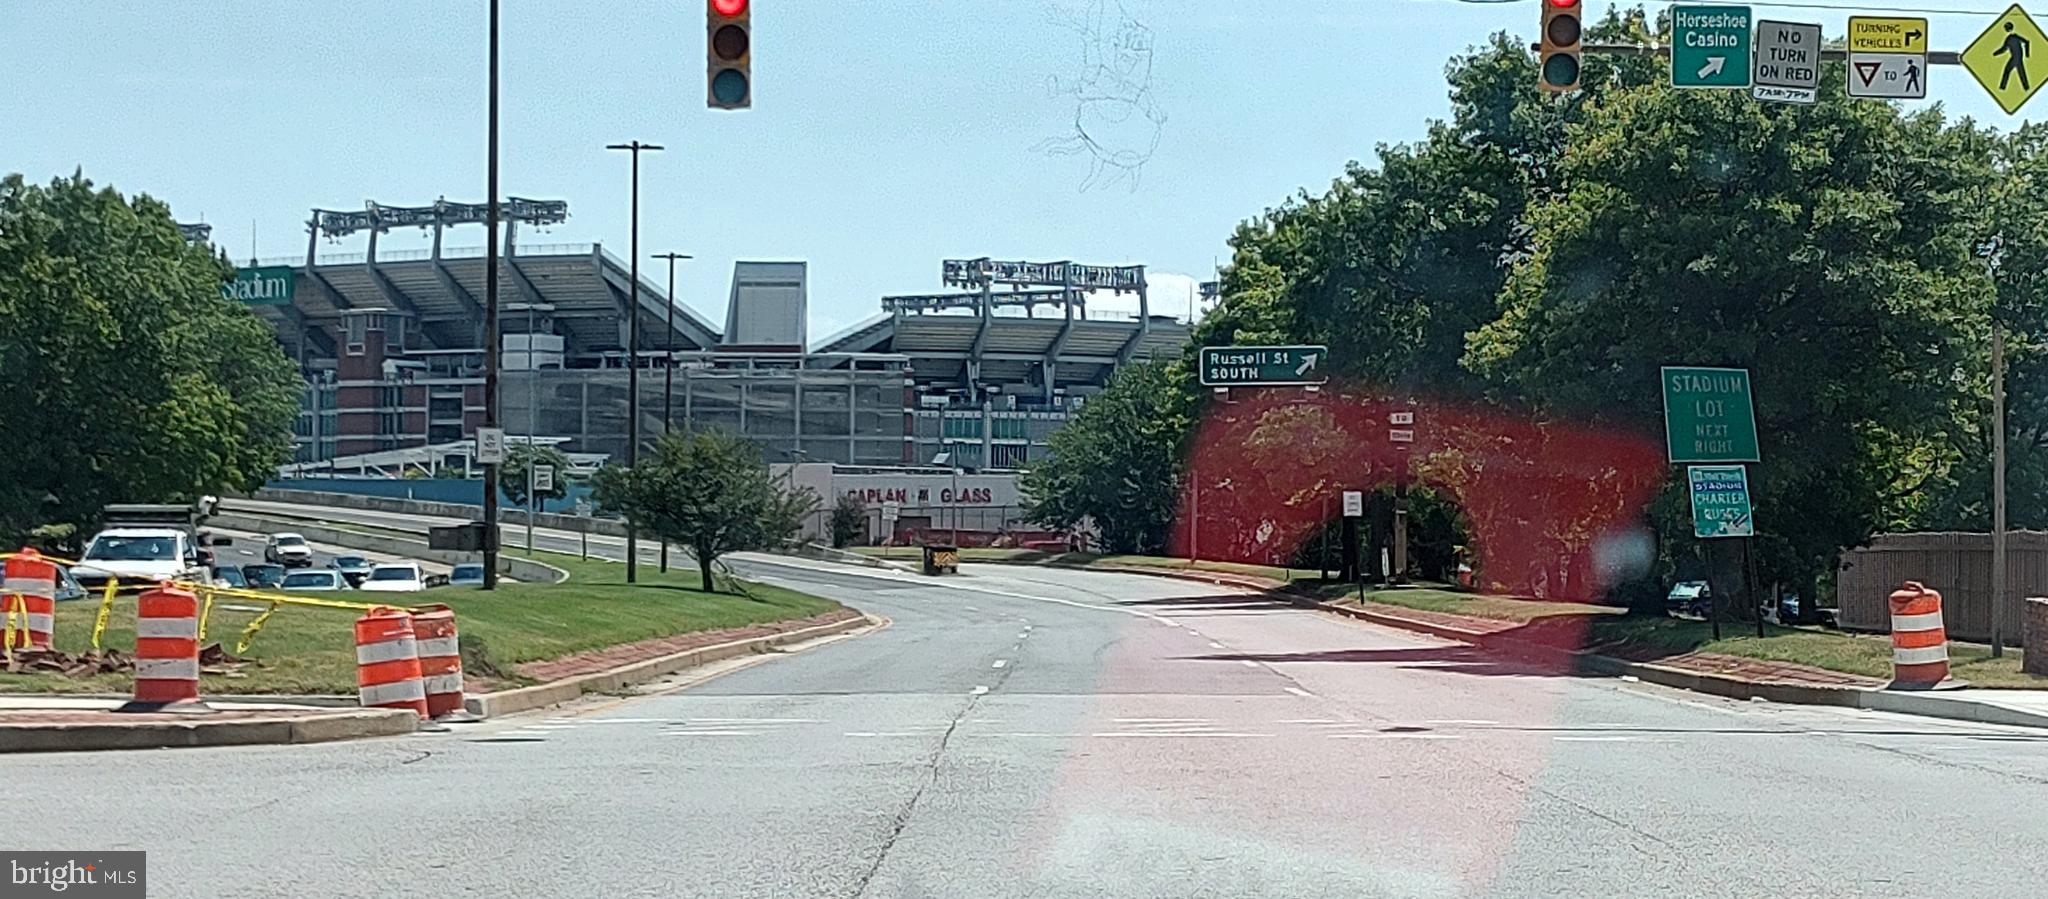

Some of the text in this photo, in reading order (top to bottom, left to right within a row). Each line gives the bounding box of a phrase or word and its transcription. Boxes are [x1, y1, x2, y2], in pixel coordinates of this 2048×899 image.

[1676, 11, 1748, 29] Horseshoe
[1856, 23, 1901, 33] TURNING
[1686, 31, 1738, 48] Casino
[1778, 28, 1801, 44] NO
[1854, 38, 1902, 48] VEHICLES
[1770, 47, 1807, 63] TURN
[1760, 63, 1813, 81] ON RED
[1884, 71, 1897, 81] TO
[1210, 351, 1289, 364] Russell St
[1210, 367, 1259, 380] SOUTH
[1672, 375, 1742, 393] STADIUM
[1696, 400, 1725, 418] LOT
[1696, 424, 1728, 438] NEXT
[1695, 440, 1733, 454] RIGHT
[941, 488, 992, 503] GLASS
[1694, 492, 1746, 505] CHARTER
